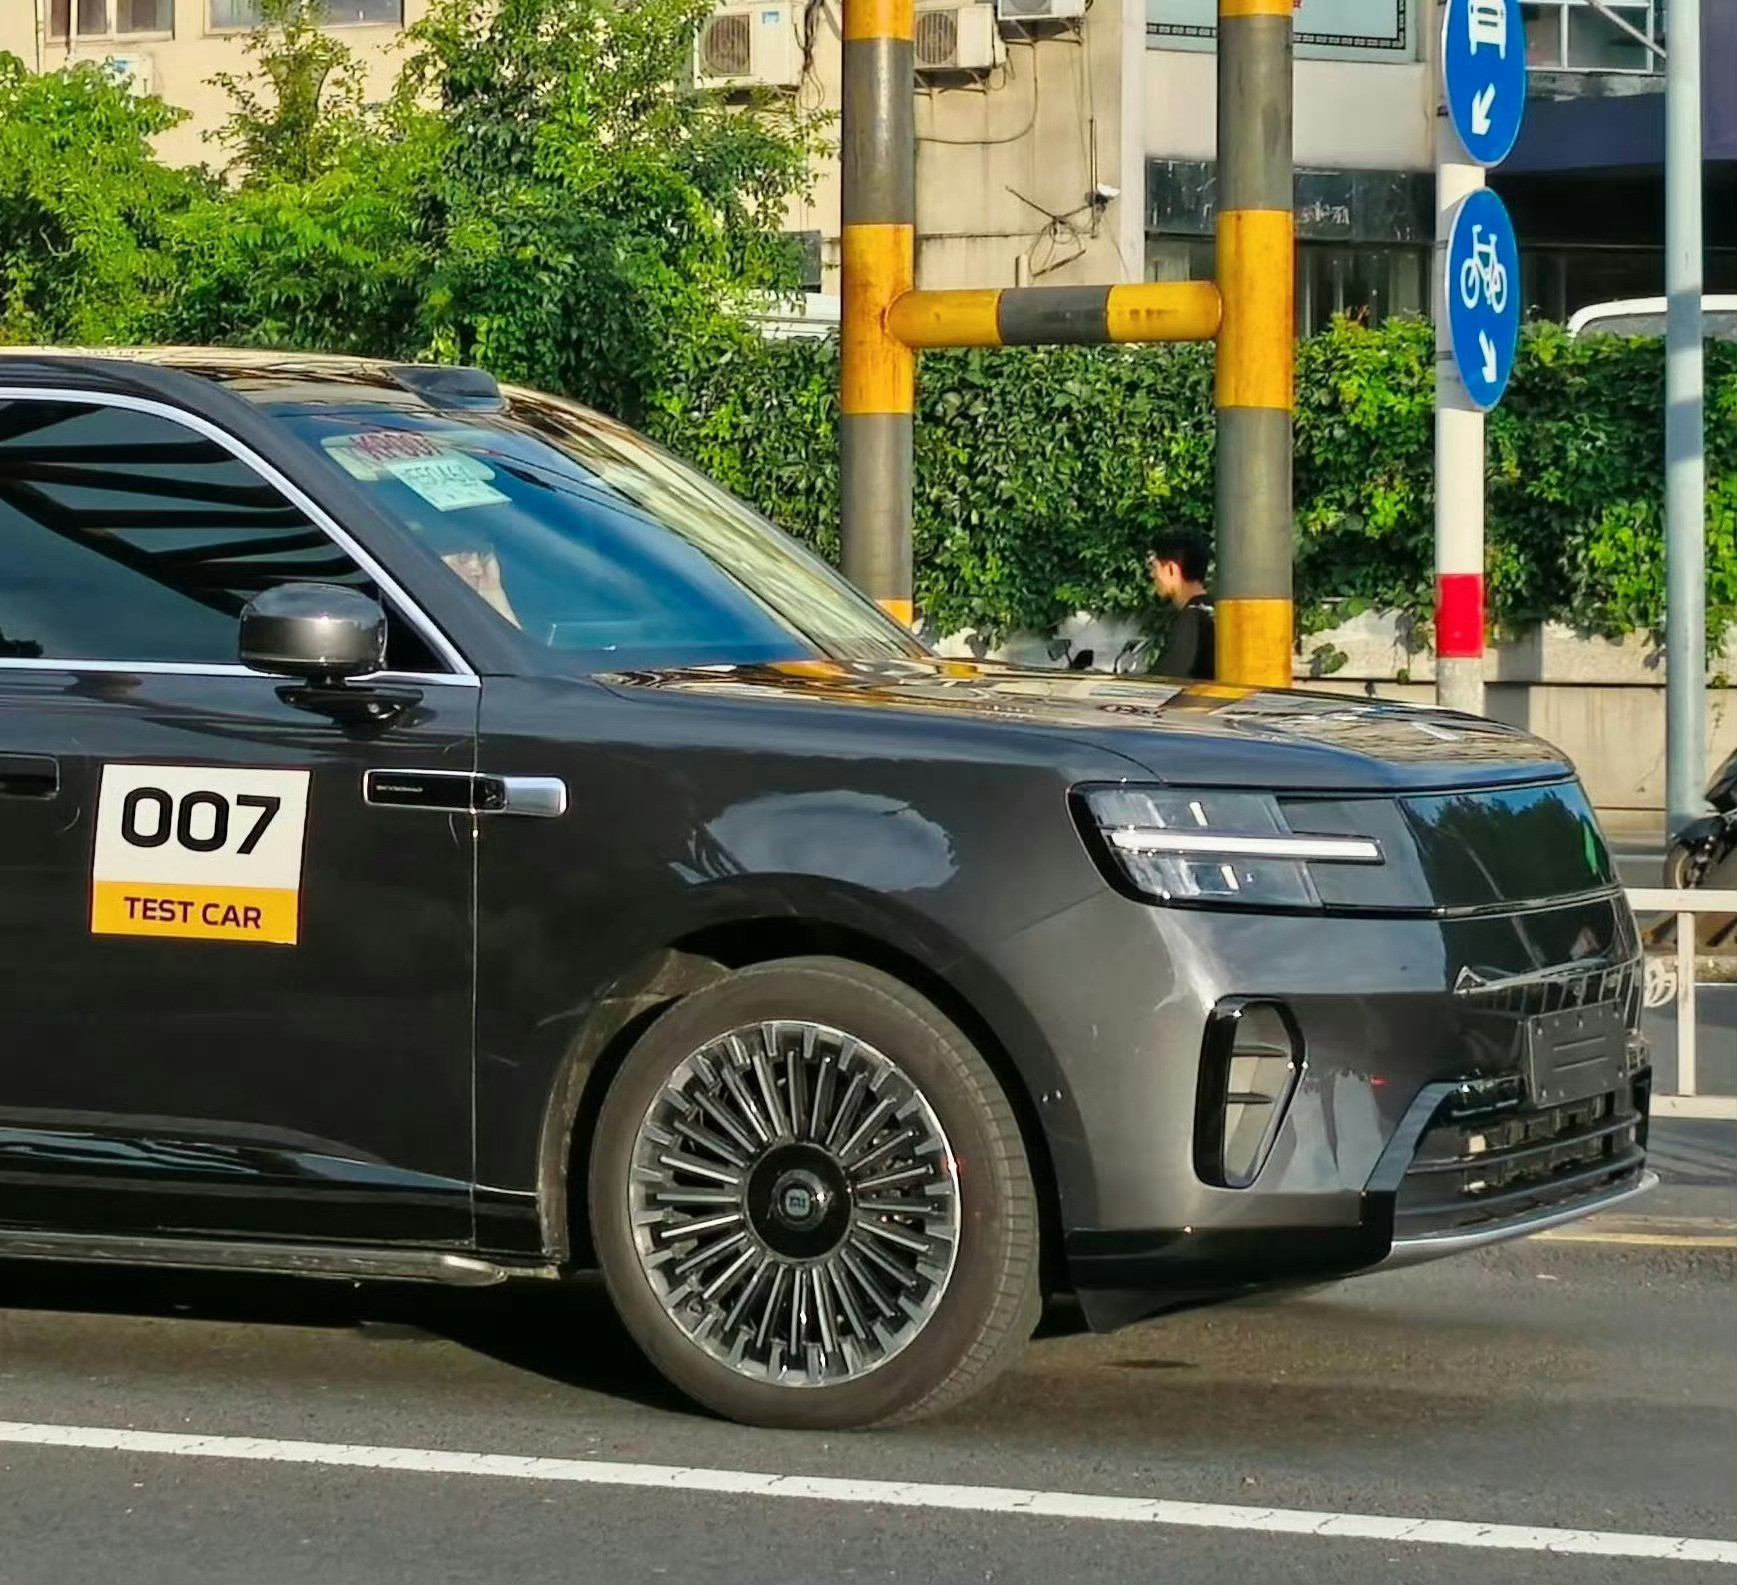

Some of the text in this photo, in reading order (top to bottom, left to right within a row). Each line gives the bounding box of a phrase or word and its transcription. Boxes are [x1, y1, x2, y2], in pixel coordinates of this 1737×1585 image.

[121, 787, 281, 855] 007
[124, 896, 262, 929] TEST CAR
